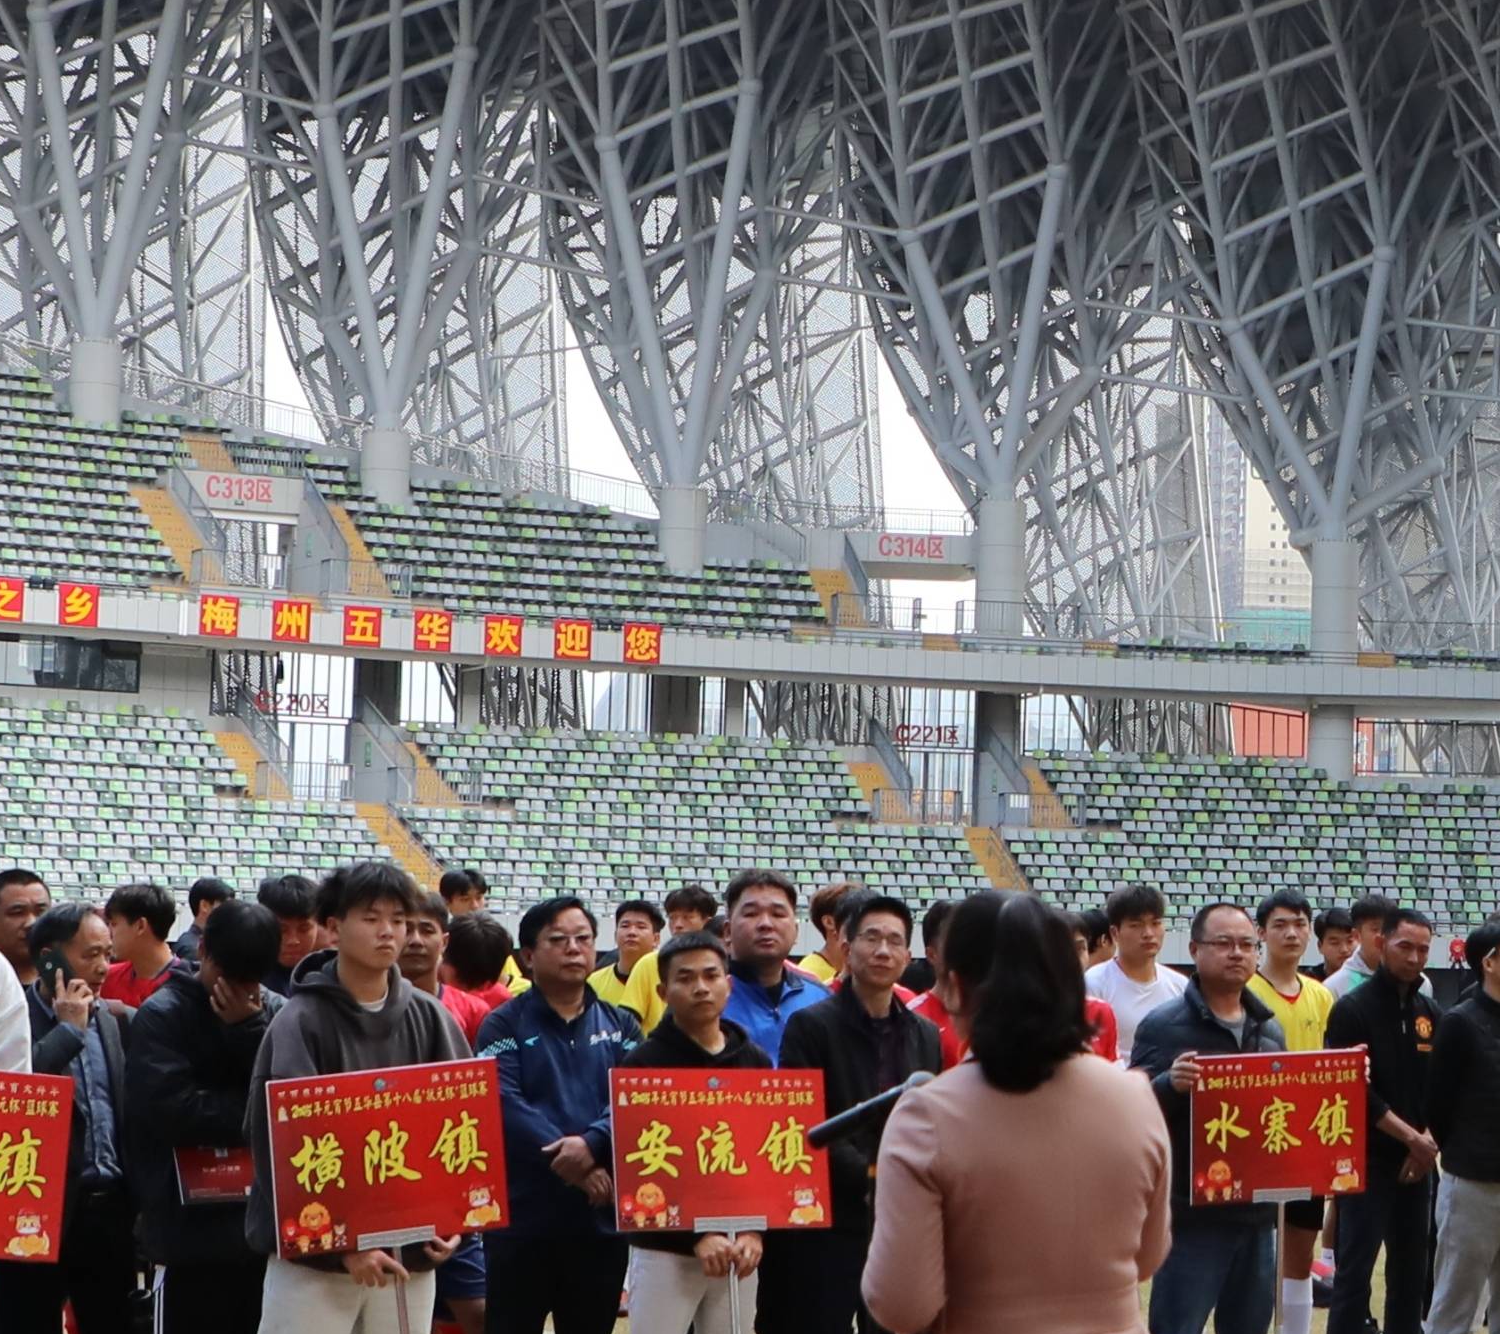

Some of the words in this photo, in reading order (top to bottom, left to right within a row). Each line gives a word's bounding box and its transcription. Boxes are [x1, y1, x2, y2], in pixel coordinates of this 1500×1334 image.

[205, 474, 273, 504] C313区
[877, 534, 944, 559] C314区
[201, 596, 661, 664] 梅州五华欢迎您
[895, 723, 959, 745] C221区
[289, 1110, 489, 1194] 横陂镇
[625, 1116, 814, 1178] 安流镇
[1204, 1092, 1354, 1155] 水寨镇
